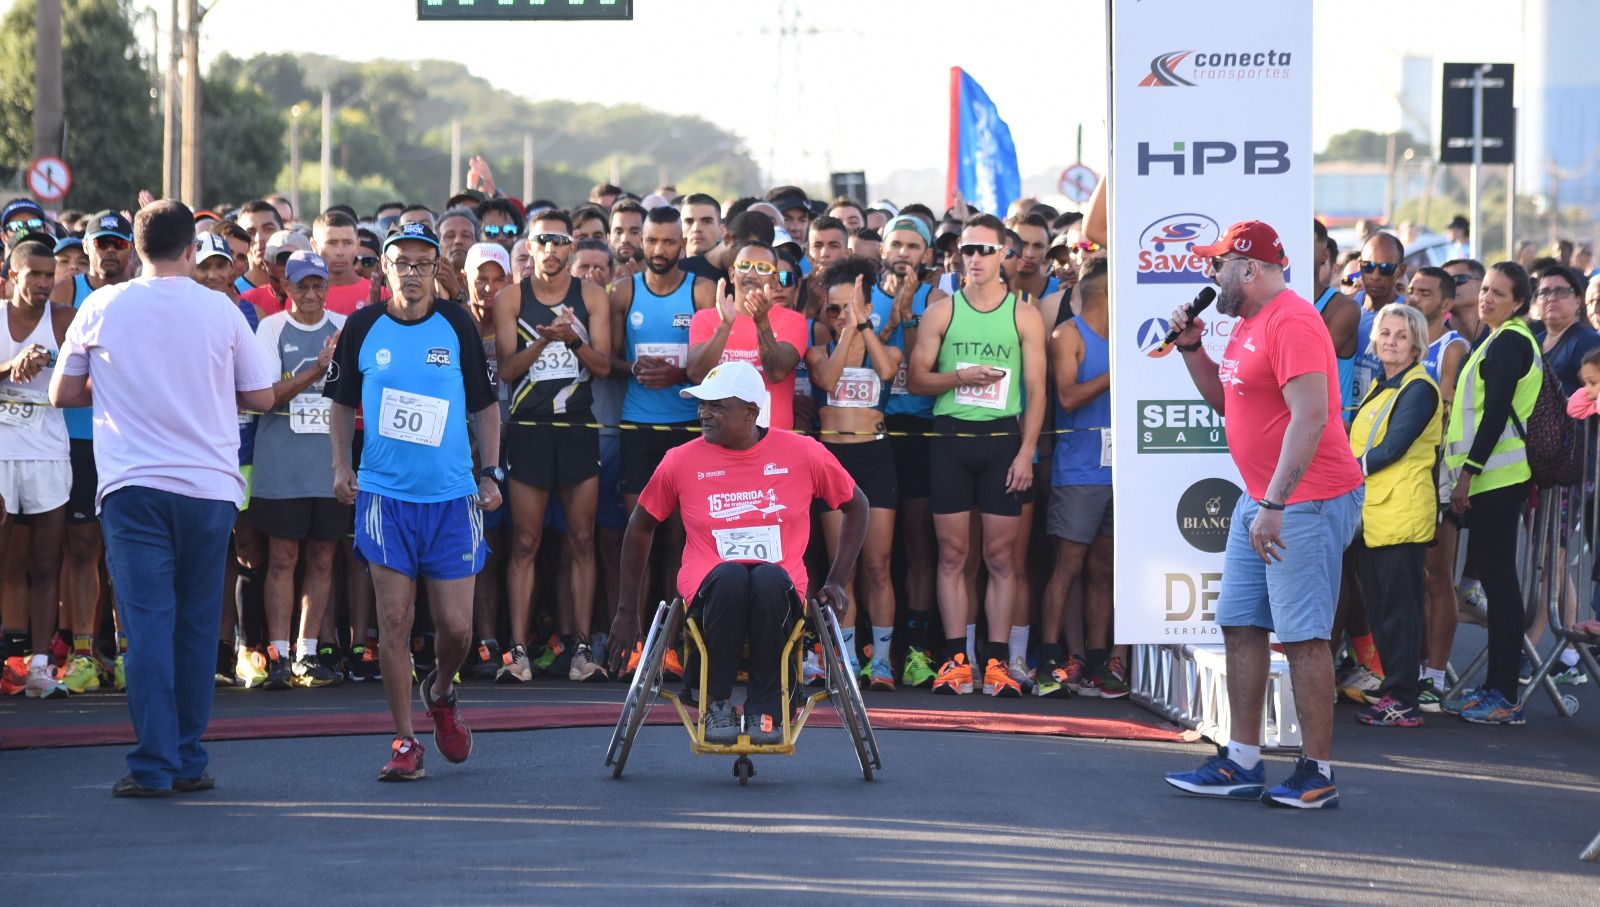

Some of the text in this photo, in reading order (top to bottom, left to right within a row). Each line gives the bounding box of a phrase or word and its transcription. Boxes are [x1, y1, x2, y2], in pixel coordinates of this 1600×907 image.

[1194, 49, 1292, 67] conecta
[1193, 67, 1290, 81] transportes
[1137, 140, 1291, 176] HPB
[426, 353, 451, 365] ISCE
[952, 342, 1012, 359] TITAN
[535, 350, 574, 371] 532
[834, 380, 870, 399] 758
[392, 408, 423, 433] 50
[1143, 429, 1220, 443] SAÚ
[724, 489, 764, 503] CORRIDA
[1183, 517, 1232, 529] BIANC
[724, 541, 768, 560] 270
[1165, 572, 1224, 622] DE
[1165, 625, 1218, 636] SERTÃO
